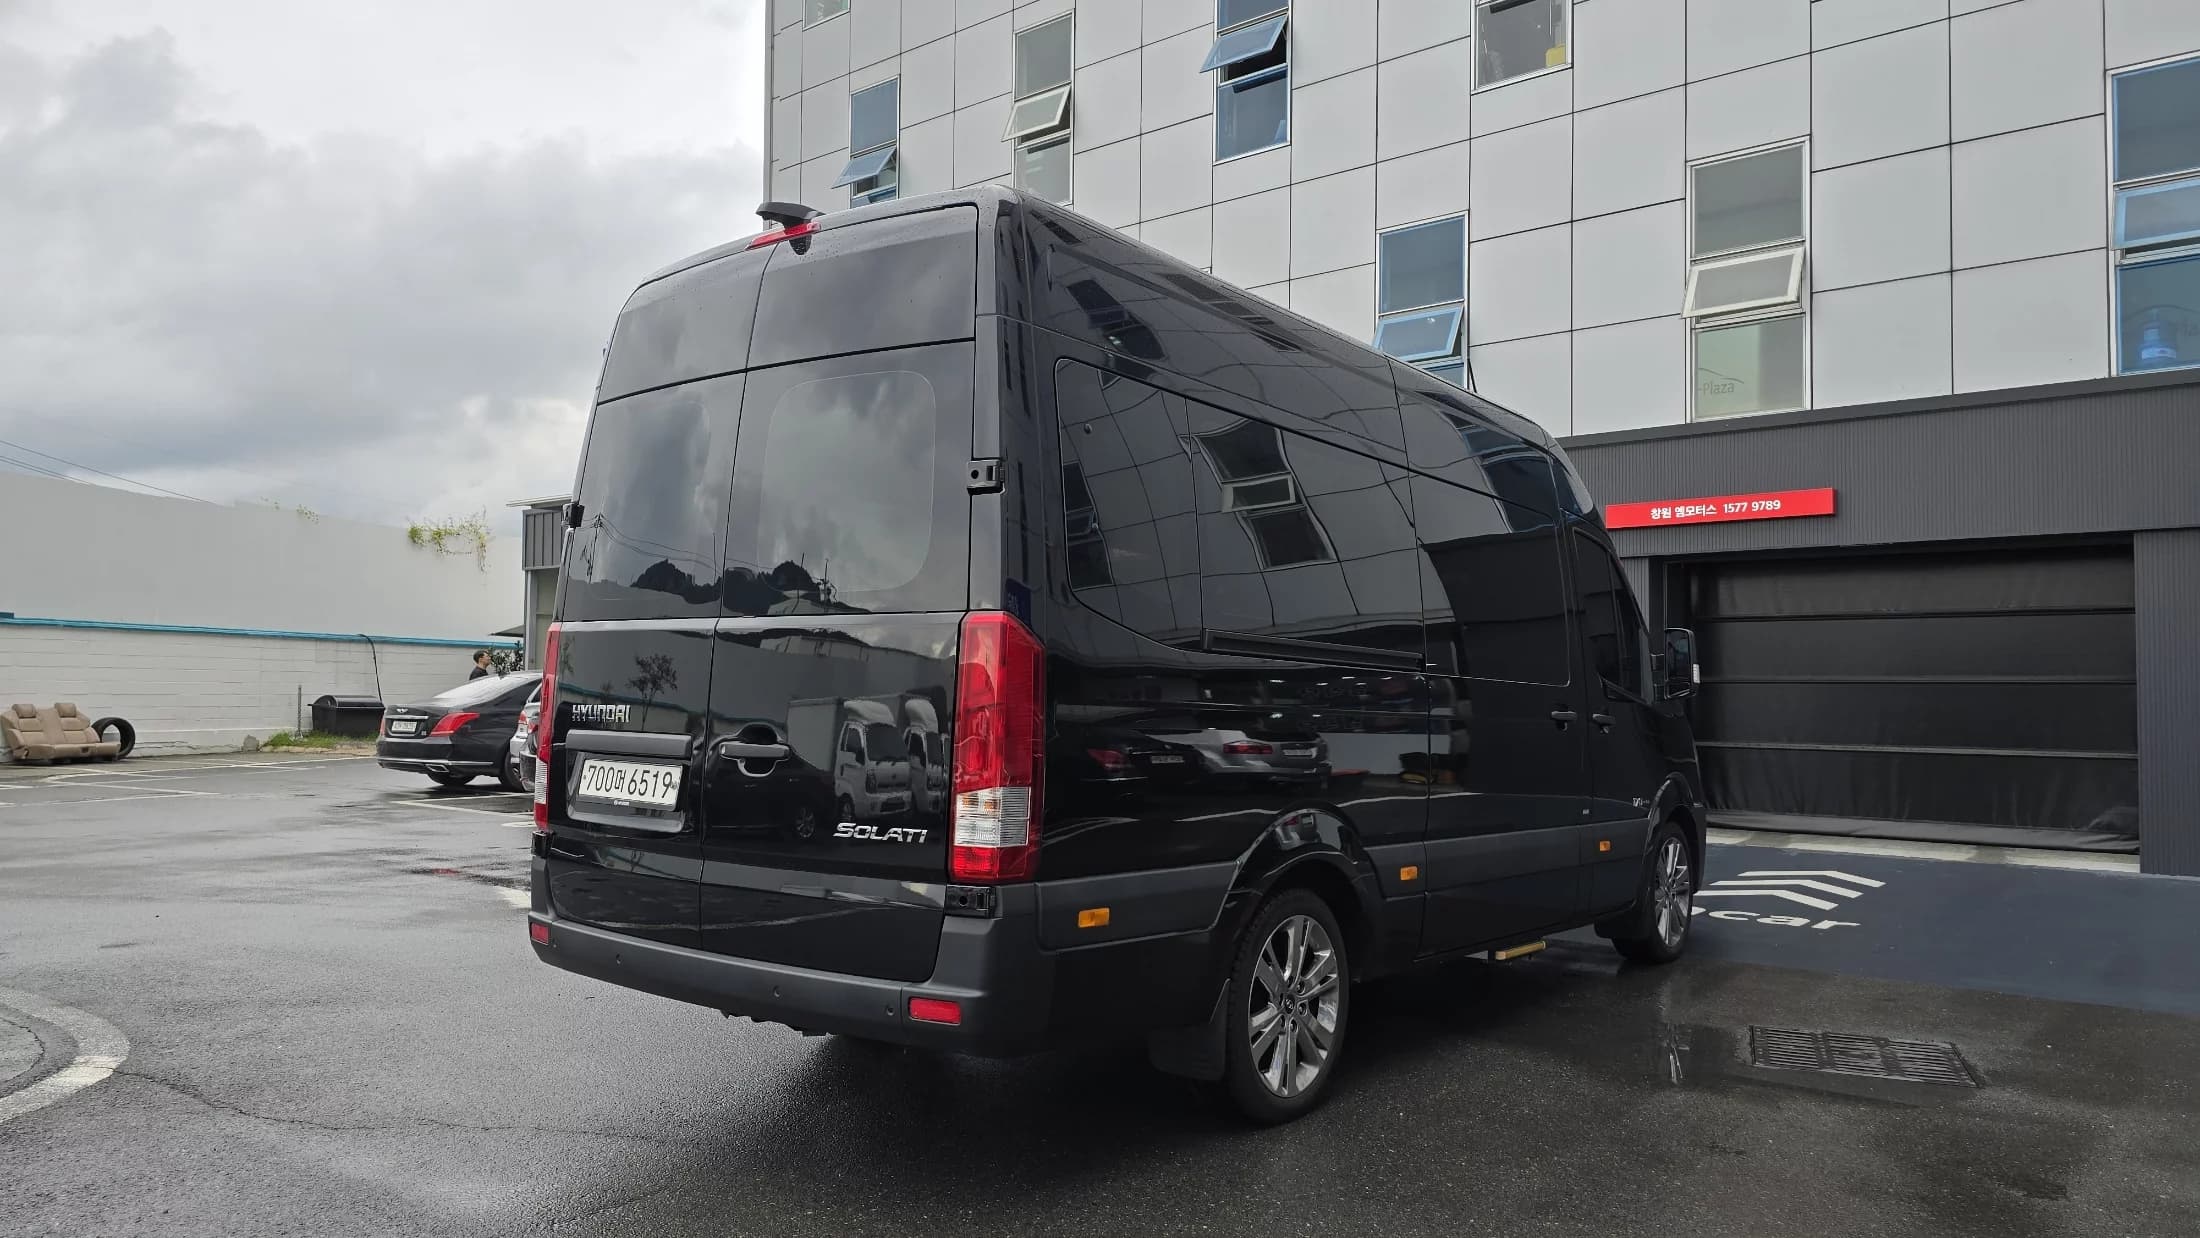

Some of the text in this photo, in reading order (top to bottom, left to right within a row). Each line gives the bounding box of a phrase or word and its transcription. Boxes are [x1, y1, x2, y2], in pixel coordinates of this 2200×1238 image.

[1650, 500, 1781, 520] 창원 엠모터스 1577 9789
[571, 704, 631, 723] HYUNDAI
[627, 769, 673, 799] 6519
[832, 822, 928, 844] SOLATI
